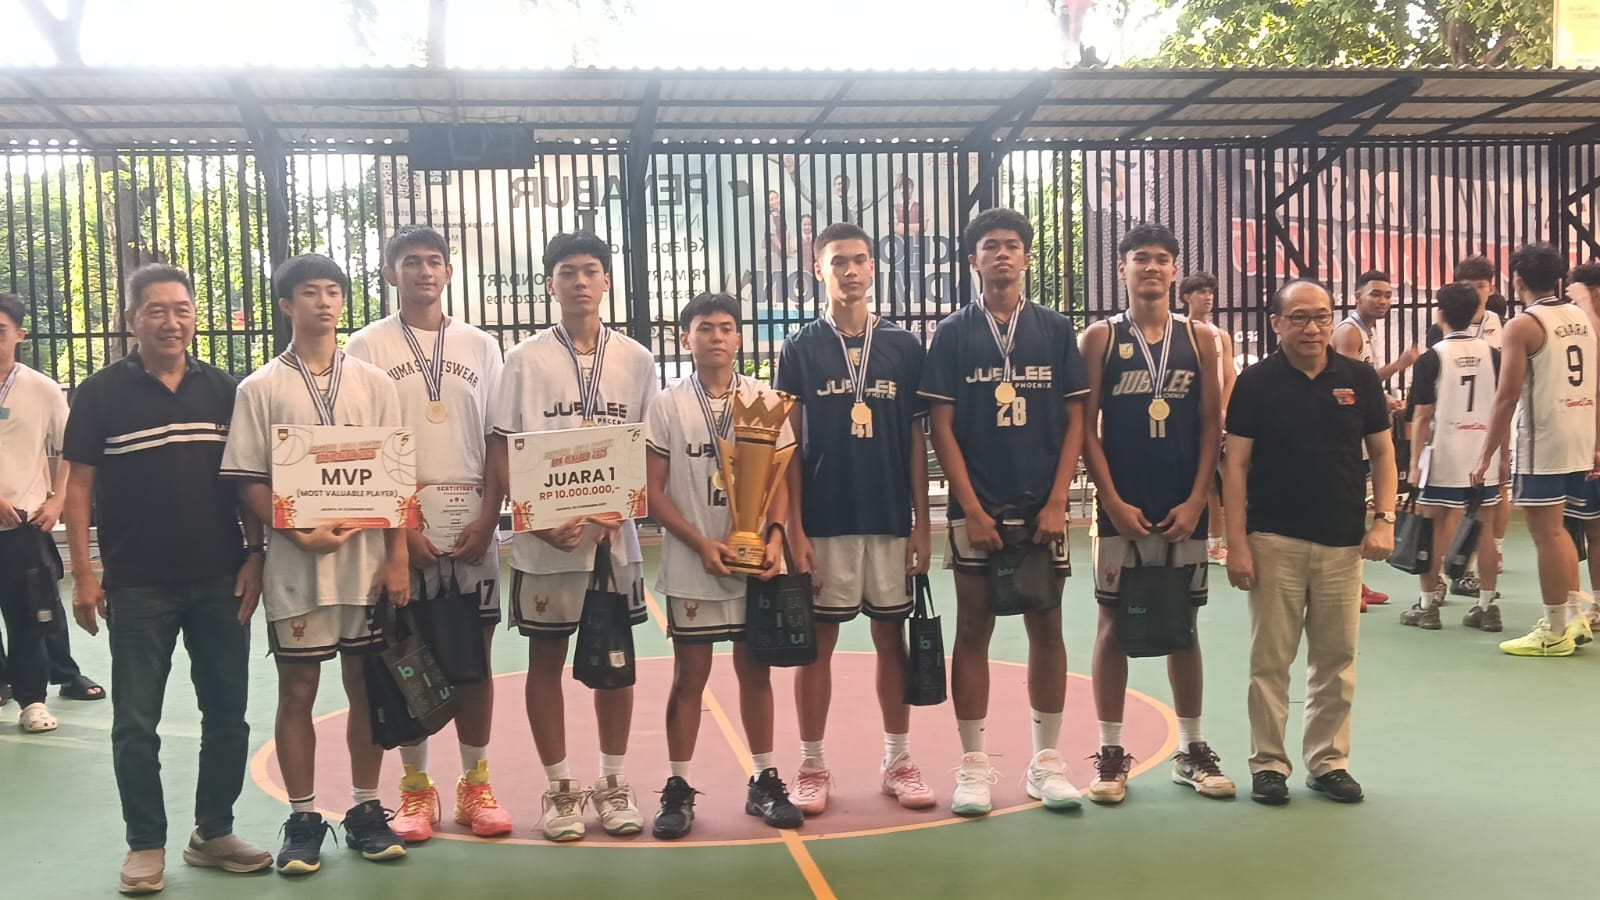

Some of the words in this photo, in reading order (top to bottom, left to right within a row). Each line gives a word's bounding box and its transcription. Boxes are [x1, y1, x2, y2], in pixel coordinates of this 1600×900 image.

[965, 365, 1053, 384] JUBLEE
[1566, 345, 1583, 387] 9
[816, 378, 897, 396] JUBLEE
[1112, 369, 1195, 397] JUBLEE
[1460, 374, 1477, 412] 7
[543, 400, 627, 419] JUBLEE
[996, 396, 1027, 427] 28
[321, 468, 373, 486] MVP
[544, 468, 605, 488] JUARA
[608, 466, 615, 481] 1
[539, 489, 553, 501] RP
[555, 485, 620, 499] 10.000.000,-
